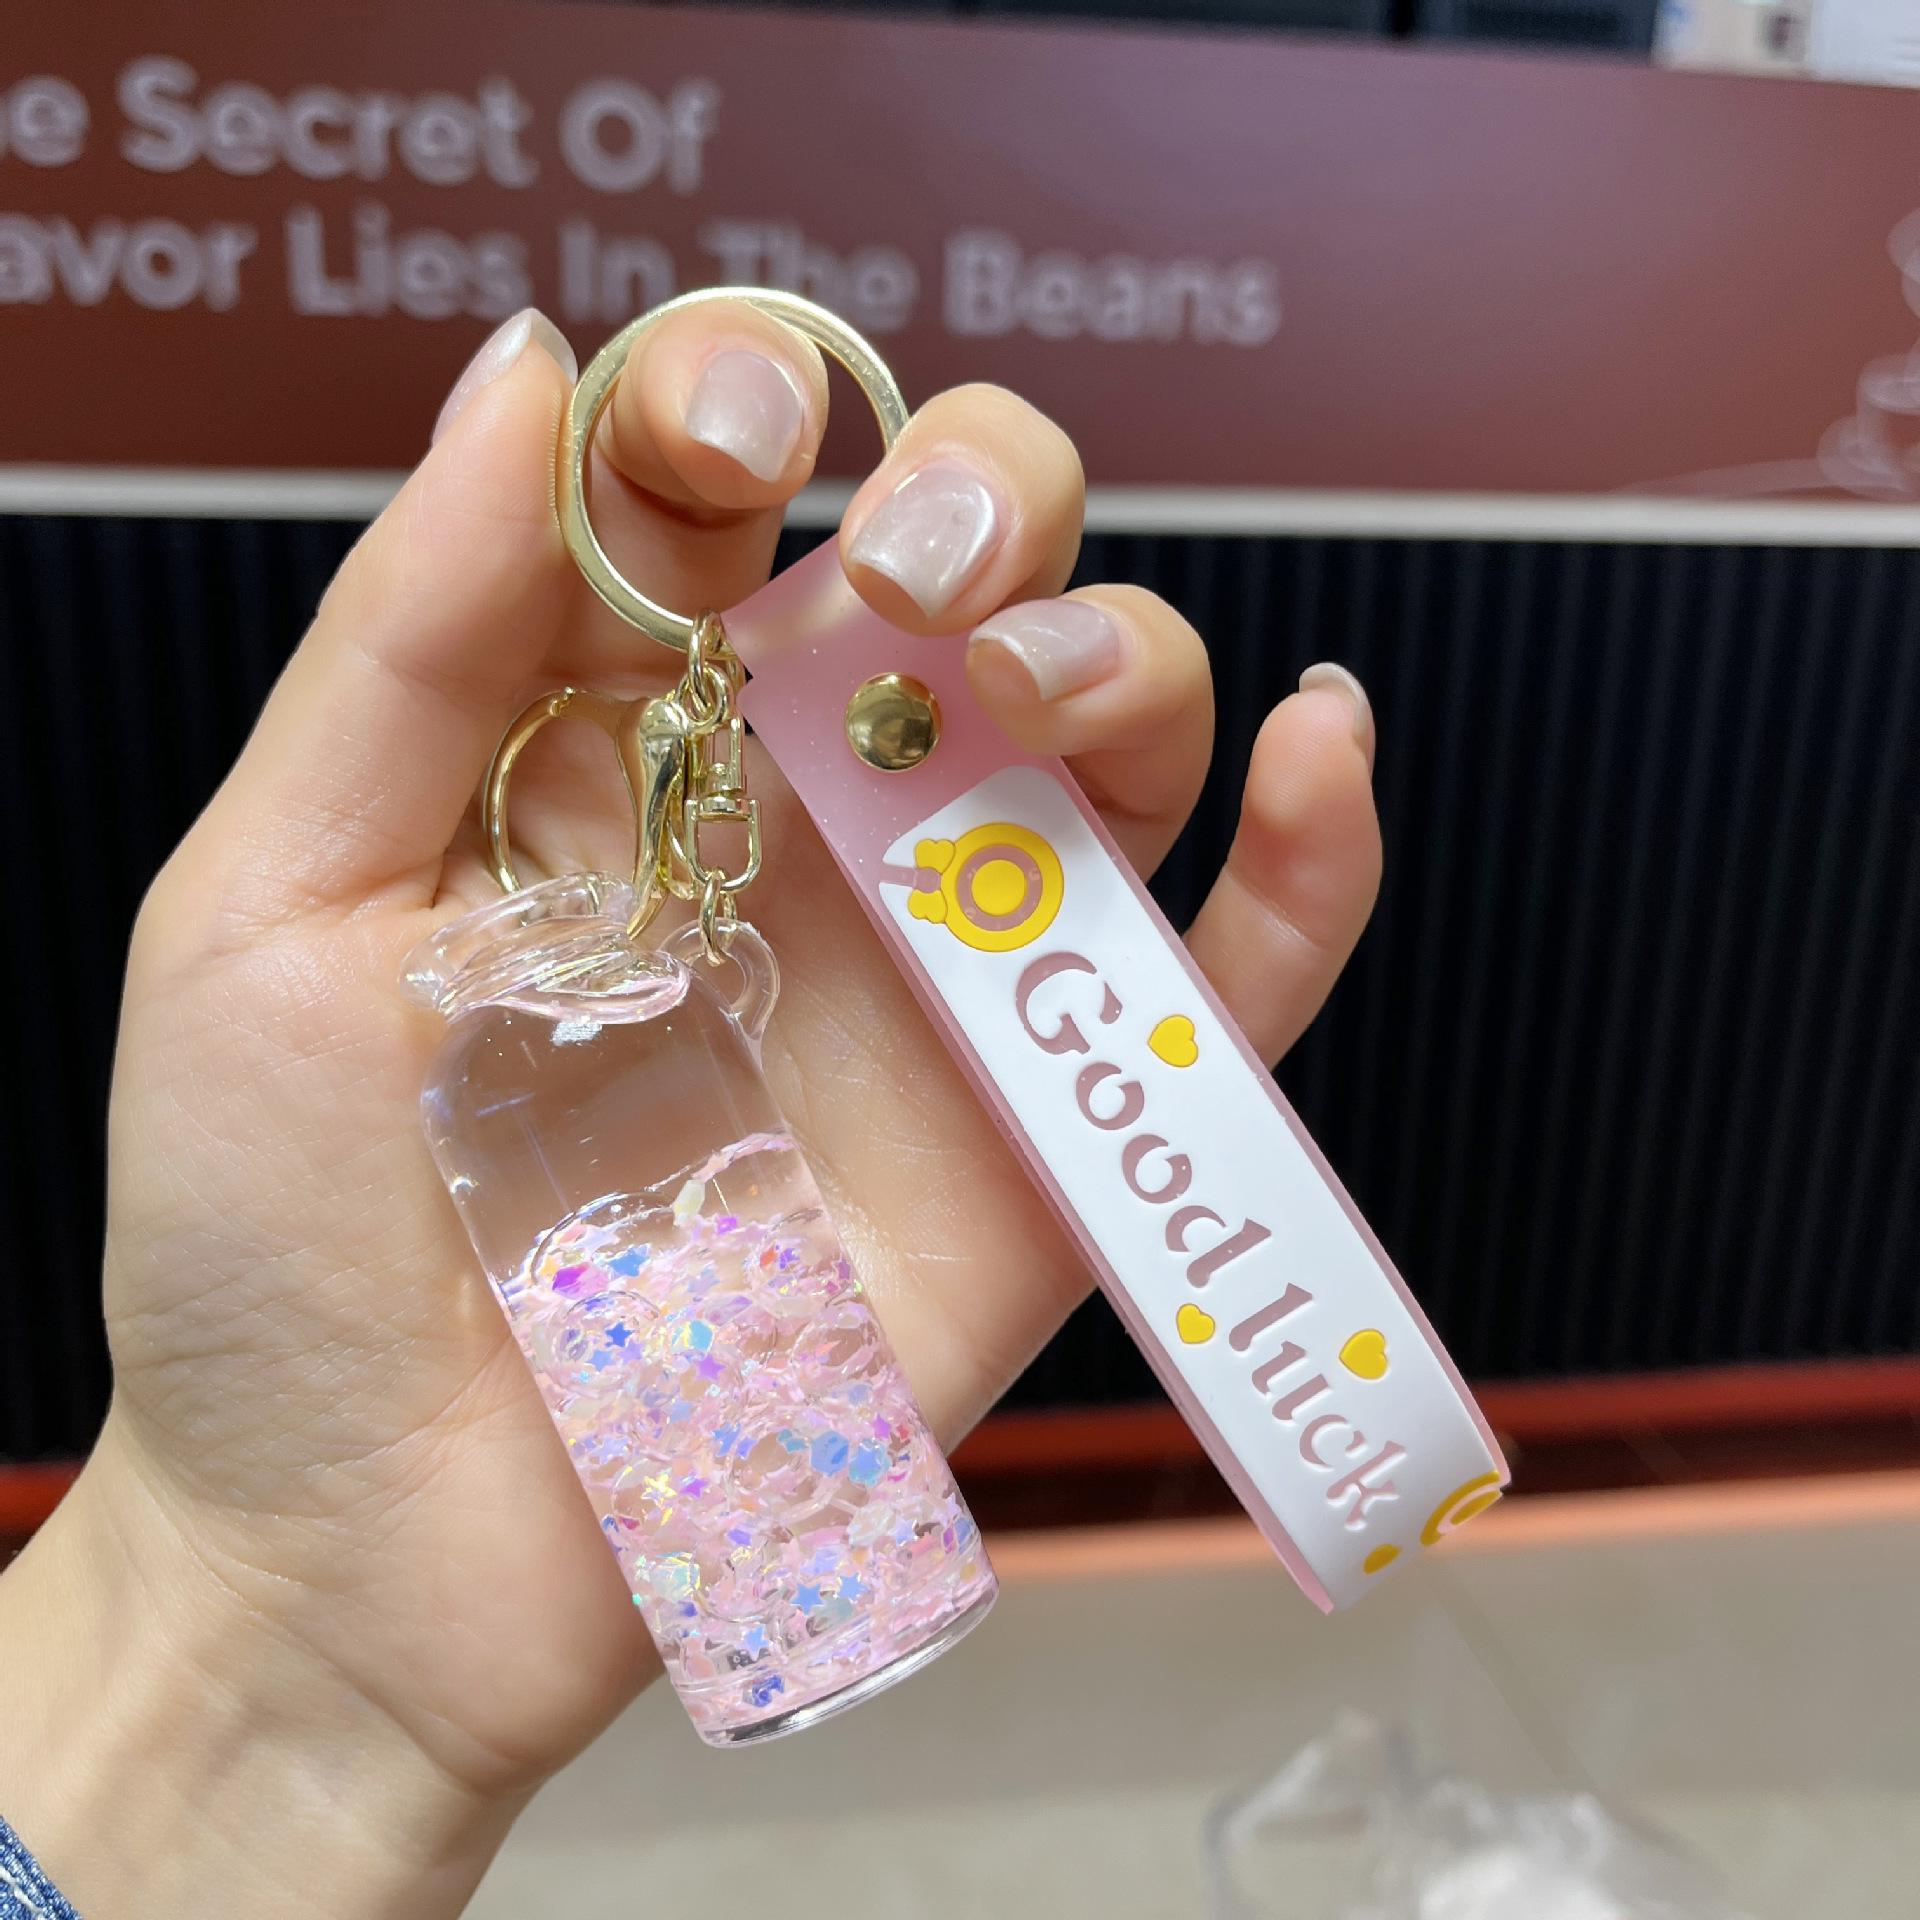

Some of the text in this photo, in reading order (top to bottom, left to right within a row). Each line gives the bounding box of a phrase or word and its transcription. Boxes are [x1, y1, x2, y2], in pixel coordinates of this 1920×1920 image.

[0, 56, 718, 193] e Secret Of
[286, 207, 533, 321] Lies
[560, 220, 676, 322] In
[703, 220, 918, 332] The
[943, 229, 1282, 346] Beans
[1015, 951, 1406, 1532] Good luck
